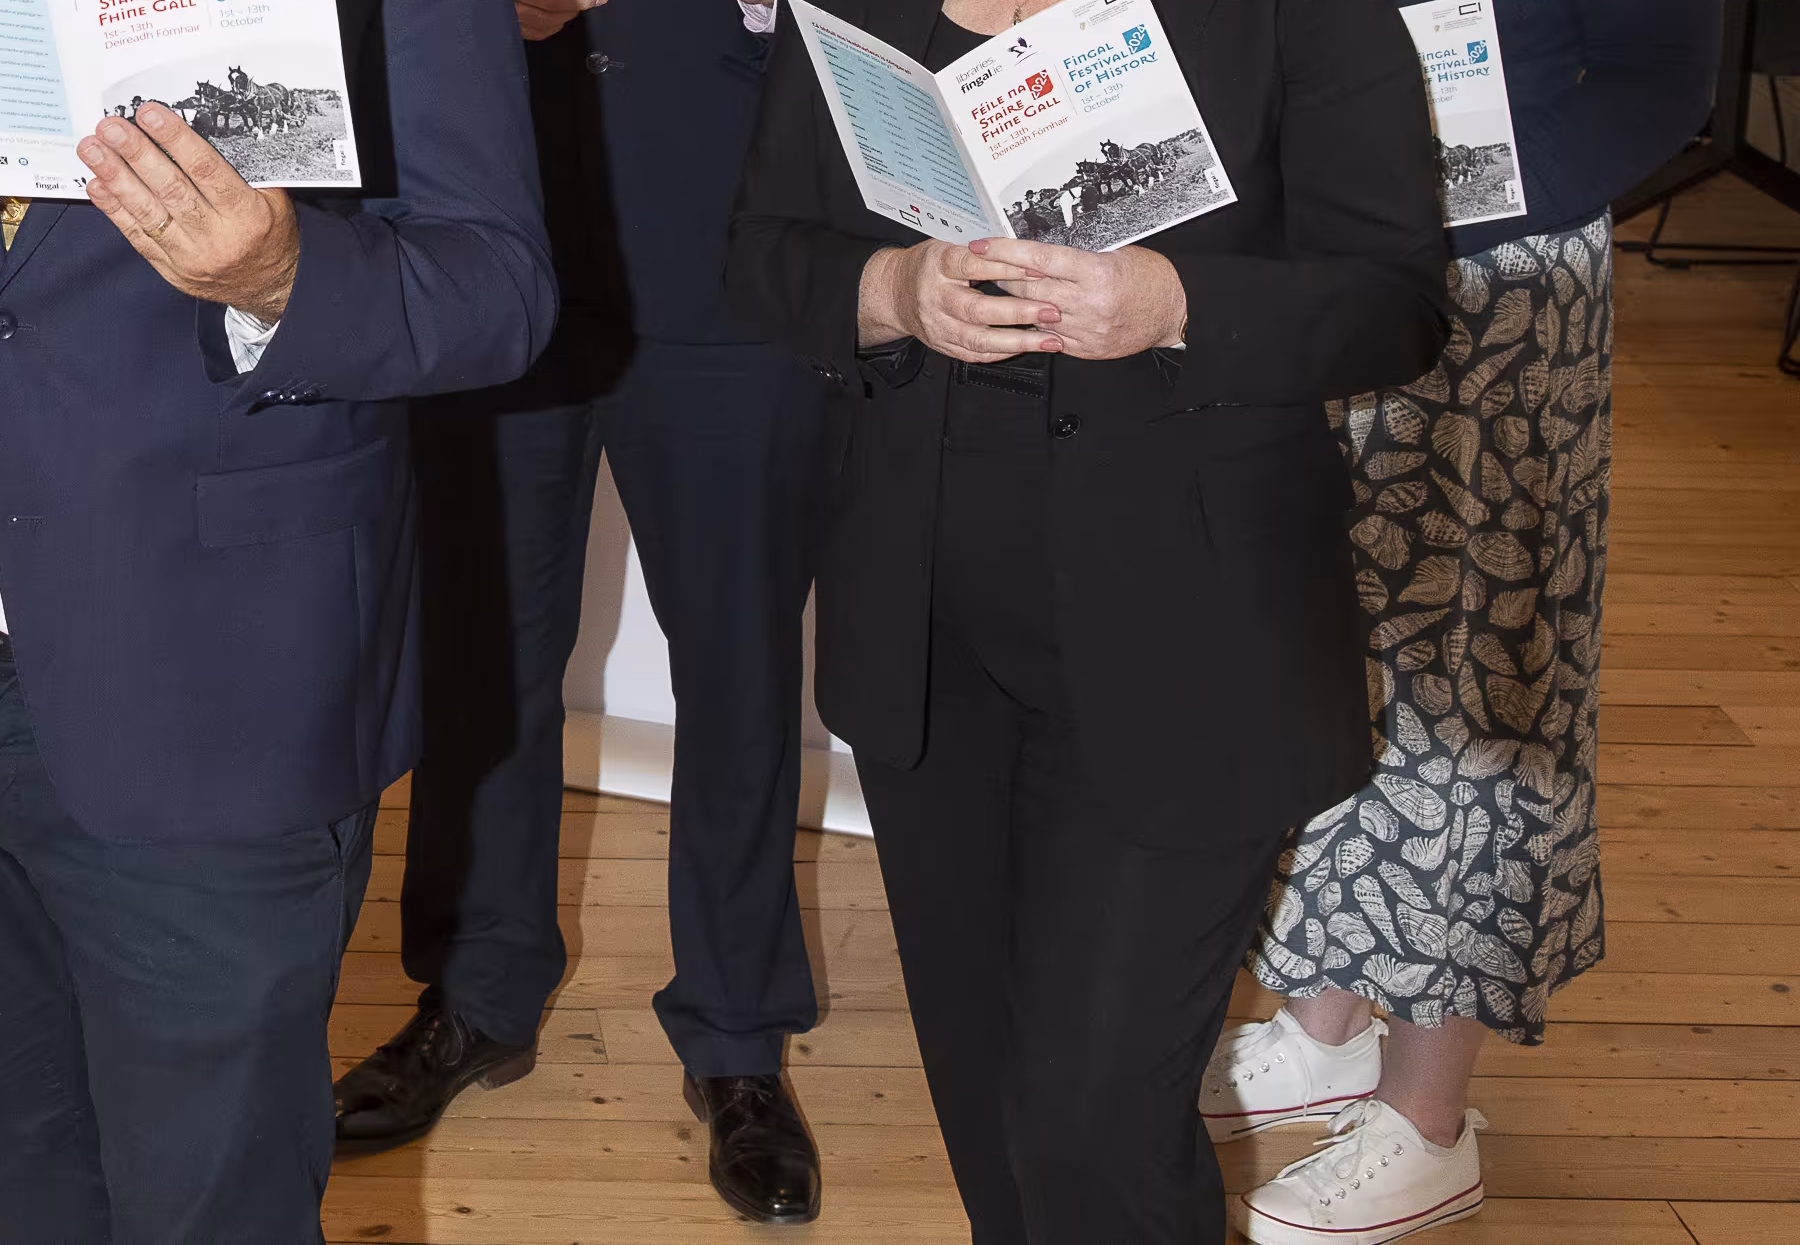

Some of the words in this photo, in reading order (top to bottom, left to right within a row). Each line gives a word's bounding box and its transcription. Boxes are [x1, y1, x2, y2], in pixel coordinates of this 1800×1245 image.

[99, 7, 147, 26] FHINE
[219, 9, 234, 18] 1st
[248, 4, 270, 14] 13th
[221, 15, 265, 28] October
[104, 30, 119, 40] 1st
[131, 21, 154, 32] 13th
[105, 30, 154, 50] Deireadh
[156, 24, 200, 38] Fómhair
[1063, 43, 1115, 70] FINGAL
[1470, 39, 1488, 64] 2024
[955, 55, 997, 85] libraries.
[960, 62, 1004, 94] fingal.ie
[1068, 51, 1129, 82] FESTIVAL
[1074, 79, 1093, 95] OF
[1097, 52, 1159, 84] HISTORY
[1438, 67, 1490, 82] HISTORY
[970, 95, 1006, 121] FÉILE
[1008, 82, 1027, 100] NA
[1081, 93, 1096, 105] 1st
[1102, 81, 1124, 96] 13th
[1084, 90, 1122, 114] October
[979, 98, 1025, 130] STAIRE
[981, 115, 1022, 143] FHINE
[1023, 96, 1062, 119] GALL
[988, 140, 1003, 153] 1st
[1009, 125, 1029, 141] 13th
[992, 133, 1032, 161] Deireadh
[1031, 115, 1070, 141] Fómhair
